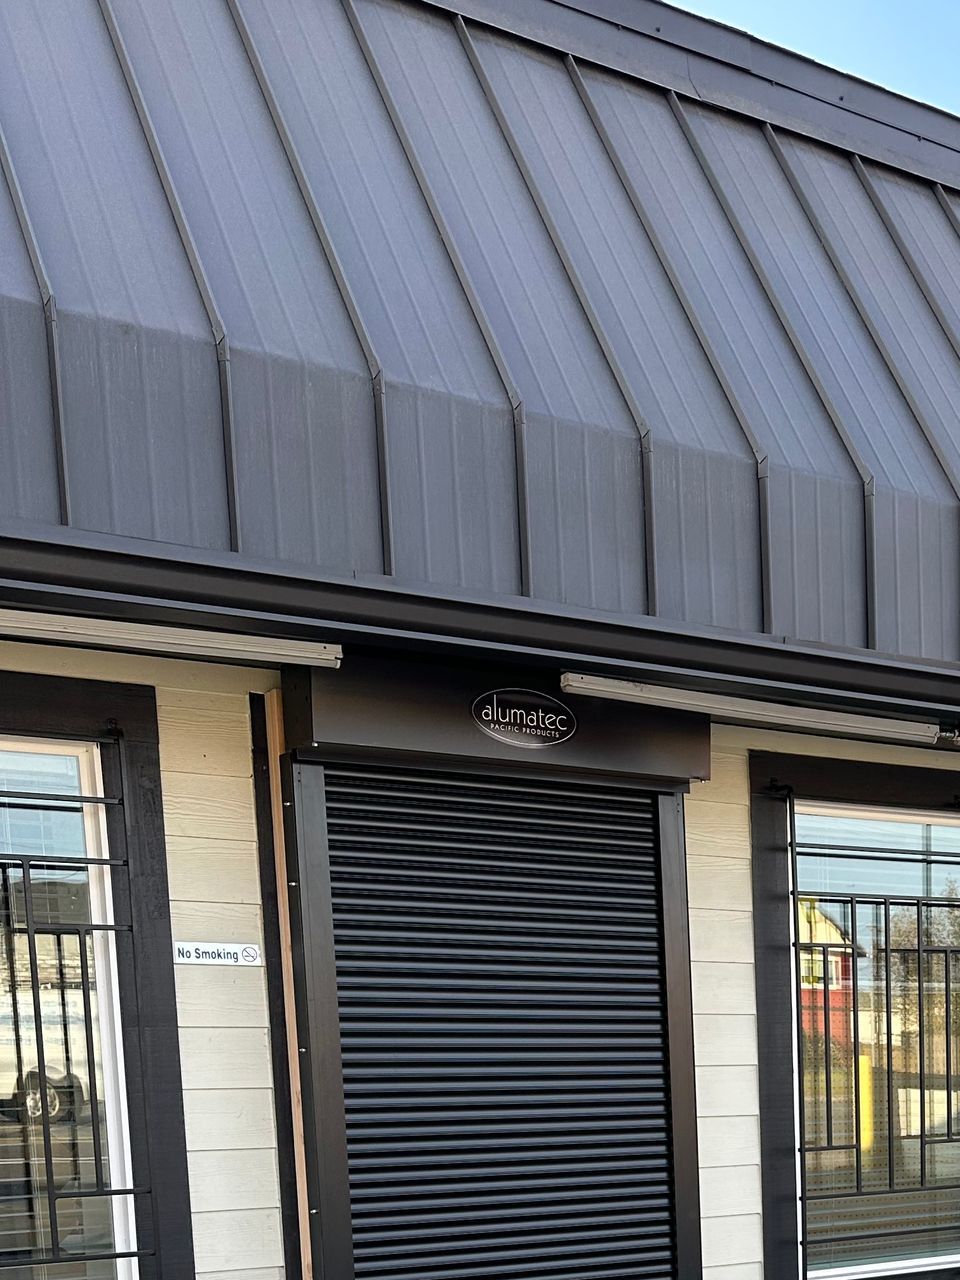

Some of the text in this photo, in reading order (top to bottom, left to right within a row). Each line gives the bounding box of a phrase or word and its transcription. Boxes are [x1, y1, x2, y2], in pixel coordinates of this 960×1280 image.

[481, 694, 568, 731] alumatec
[490, 722, 560, 738] PACIFIC PRODUCTS
[177, 947, 239, 963] No Smoking
